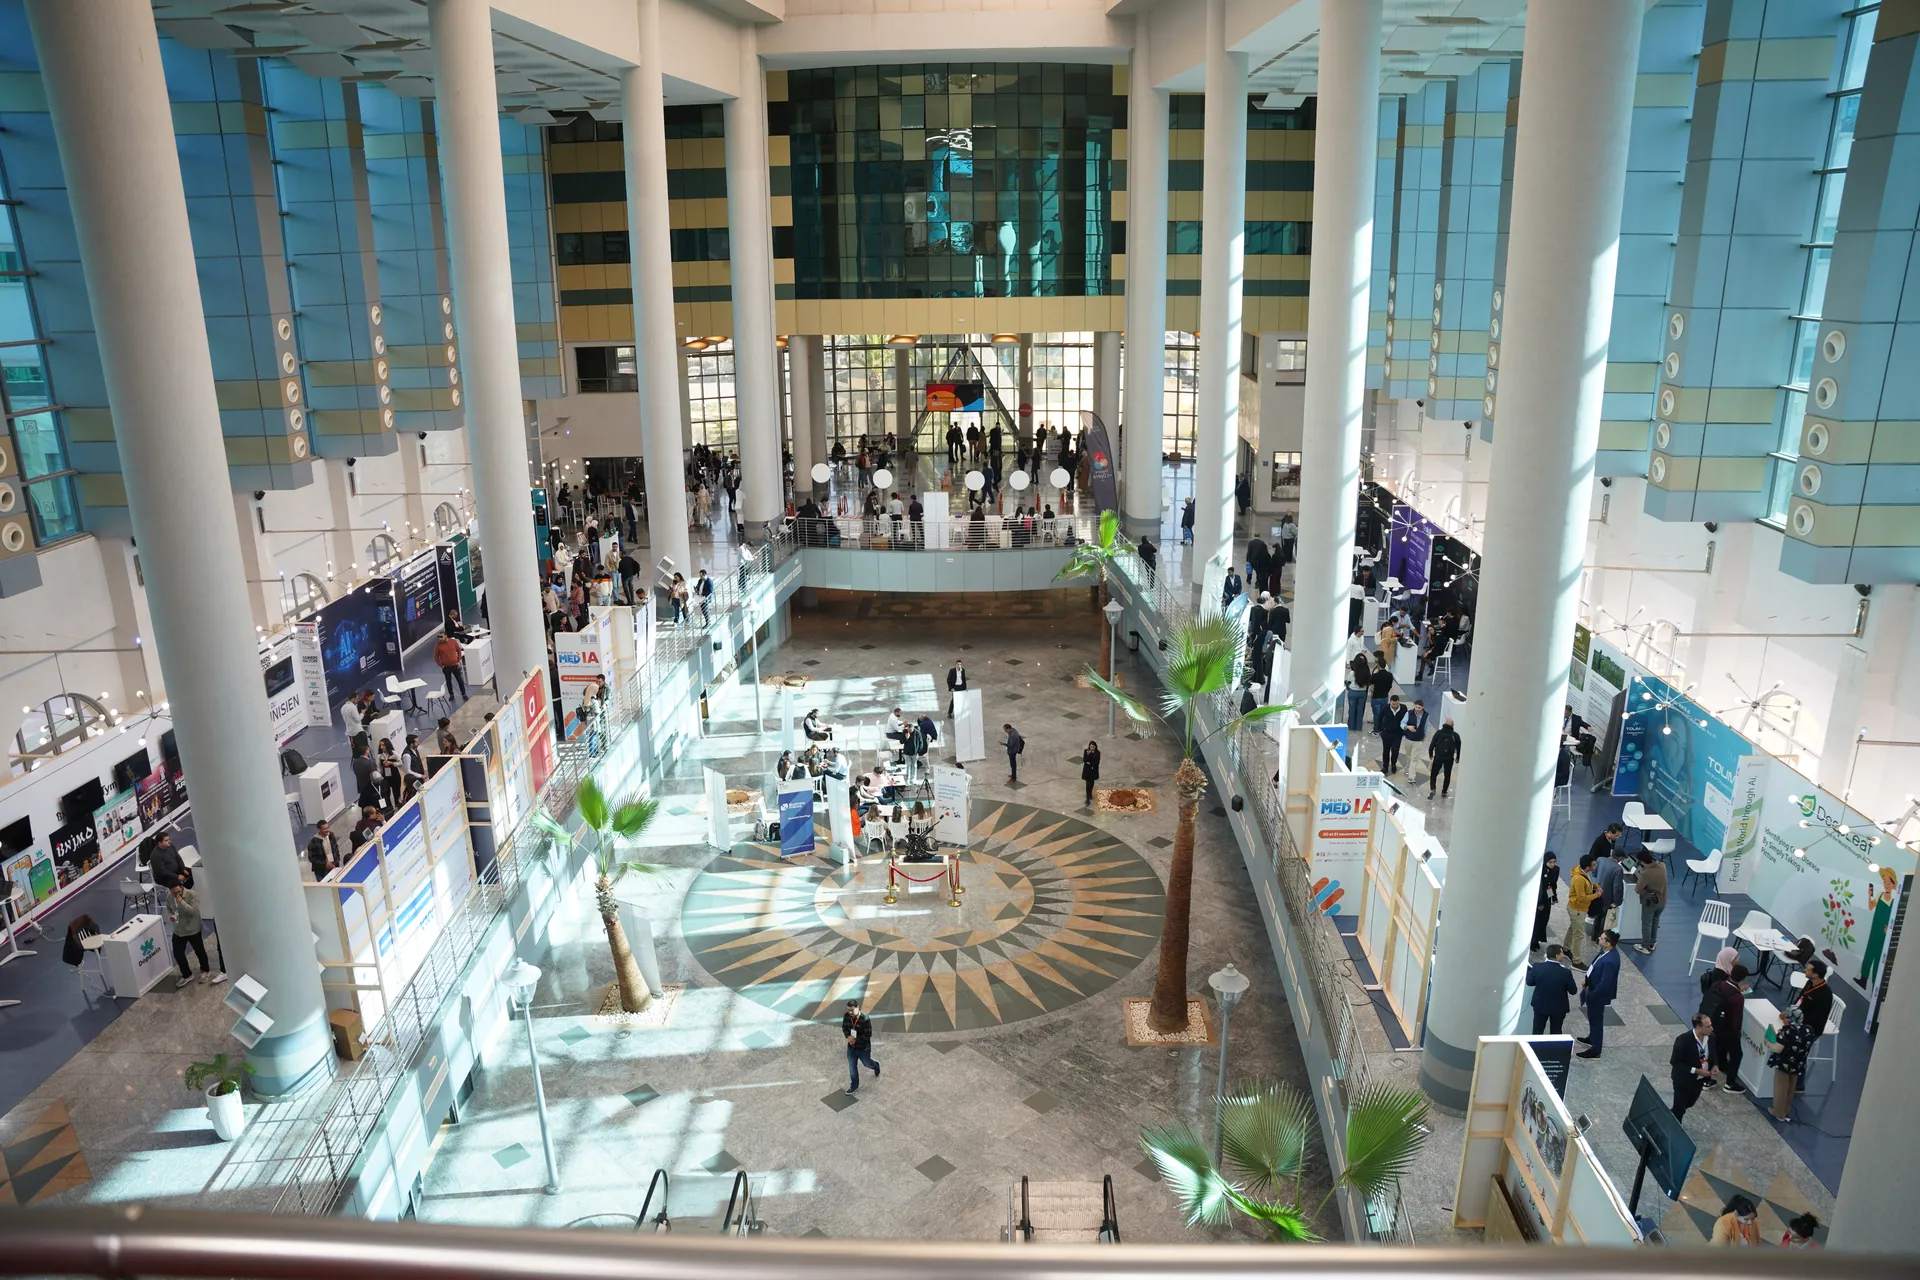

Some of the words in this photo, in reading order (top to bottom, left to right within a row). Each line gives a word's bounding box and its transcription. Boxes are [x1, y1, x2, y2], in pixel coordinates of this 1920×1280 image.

[1321, 802, 1352, 815] MED
[1742, 788, 1755, 821] through
[1736, 823, 1748, 847] World
[1764, 826, 1790, 852] Identifying
[1734, 848, 1742, 861] the
[1761, 846, 1777, 864] Picture
[1763, 837, 1769, 847] By
[1768, 841, 1785, 859] Simply
[1785, 853, 1801, 872] Taking
[1729, 863, 1740, 882] Feed
